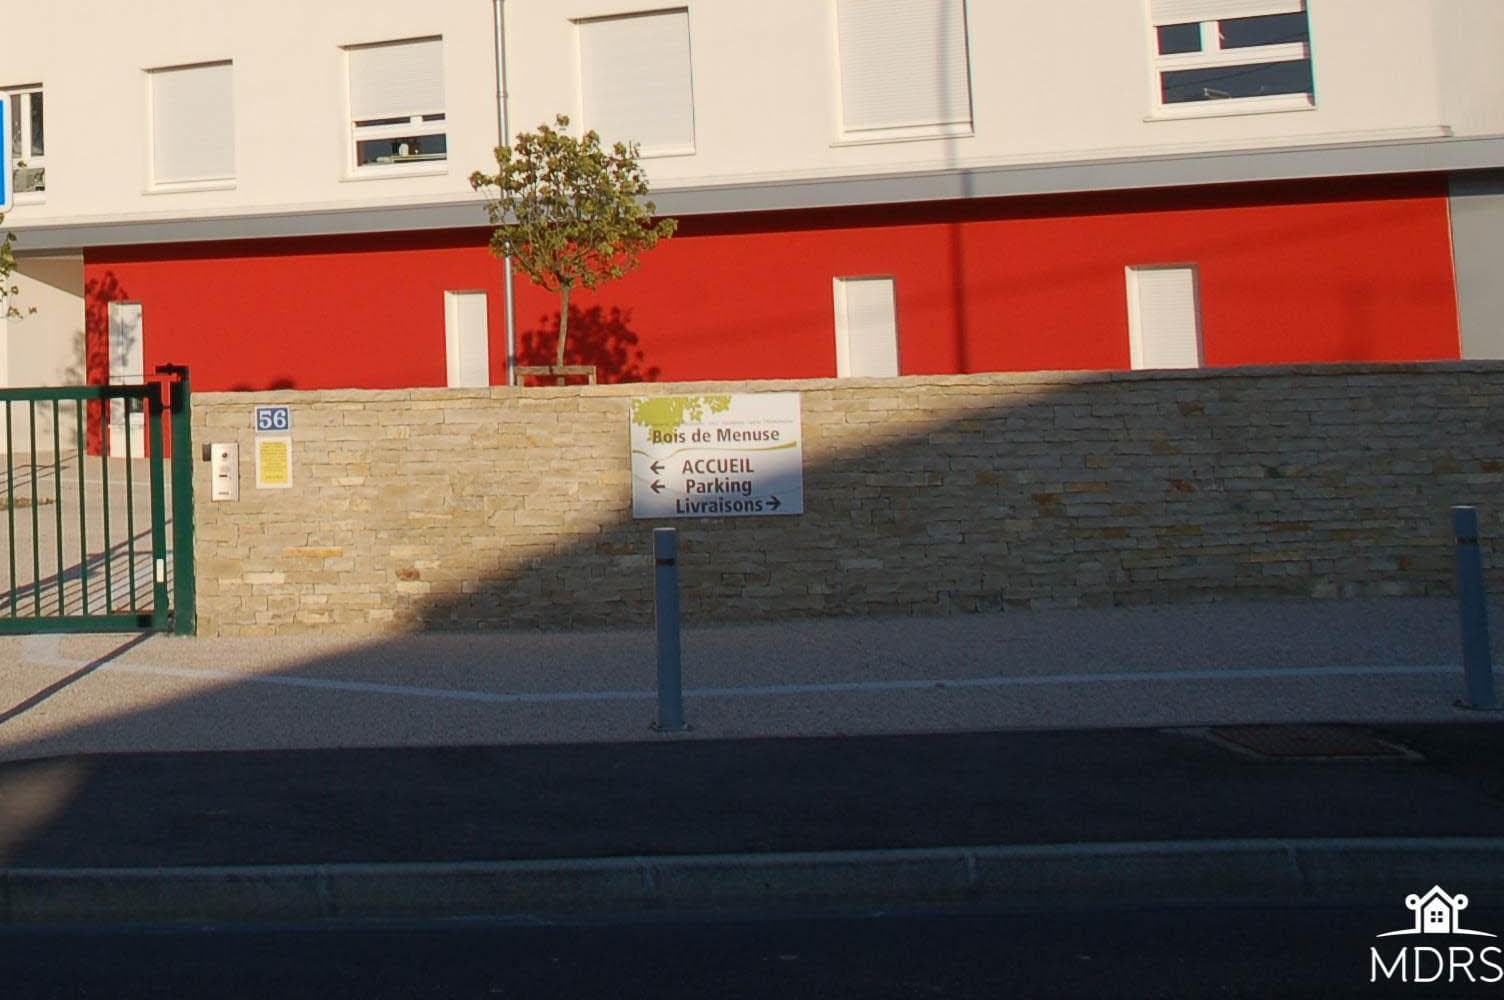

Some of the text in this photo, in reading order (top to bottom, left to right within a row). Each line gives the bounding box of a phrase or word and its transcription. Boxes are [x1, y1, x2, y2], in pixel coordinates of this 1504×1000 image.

[259, 409, 287, 429] 56
[652, 428, 780, 444] Bois de Menuse
[682, 458, 755, 474] ACCUEIL
[685, 477, 753, 496] Parking
[676, 497, 764, 514] Livraisons
